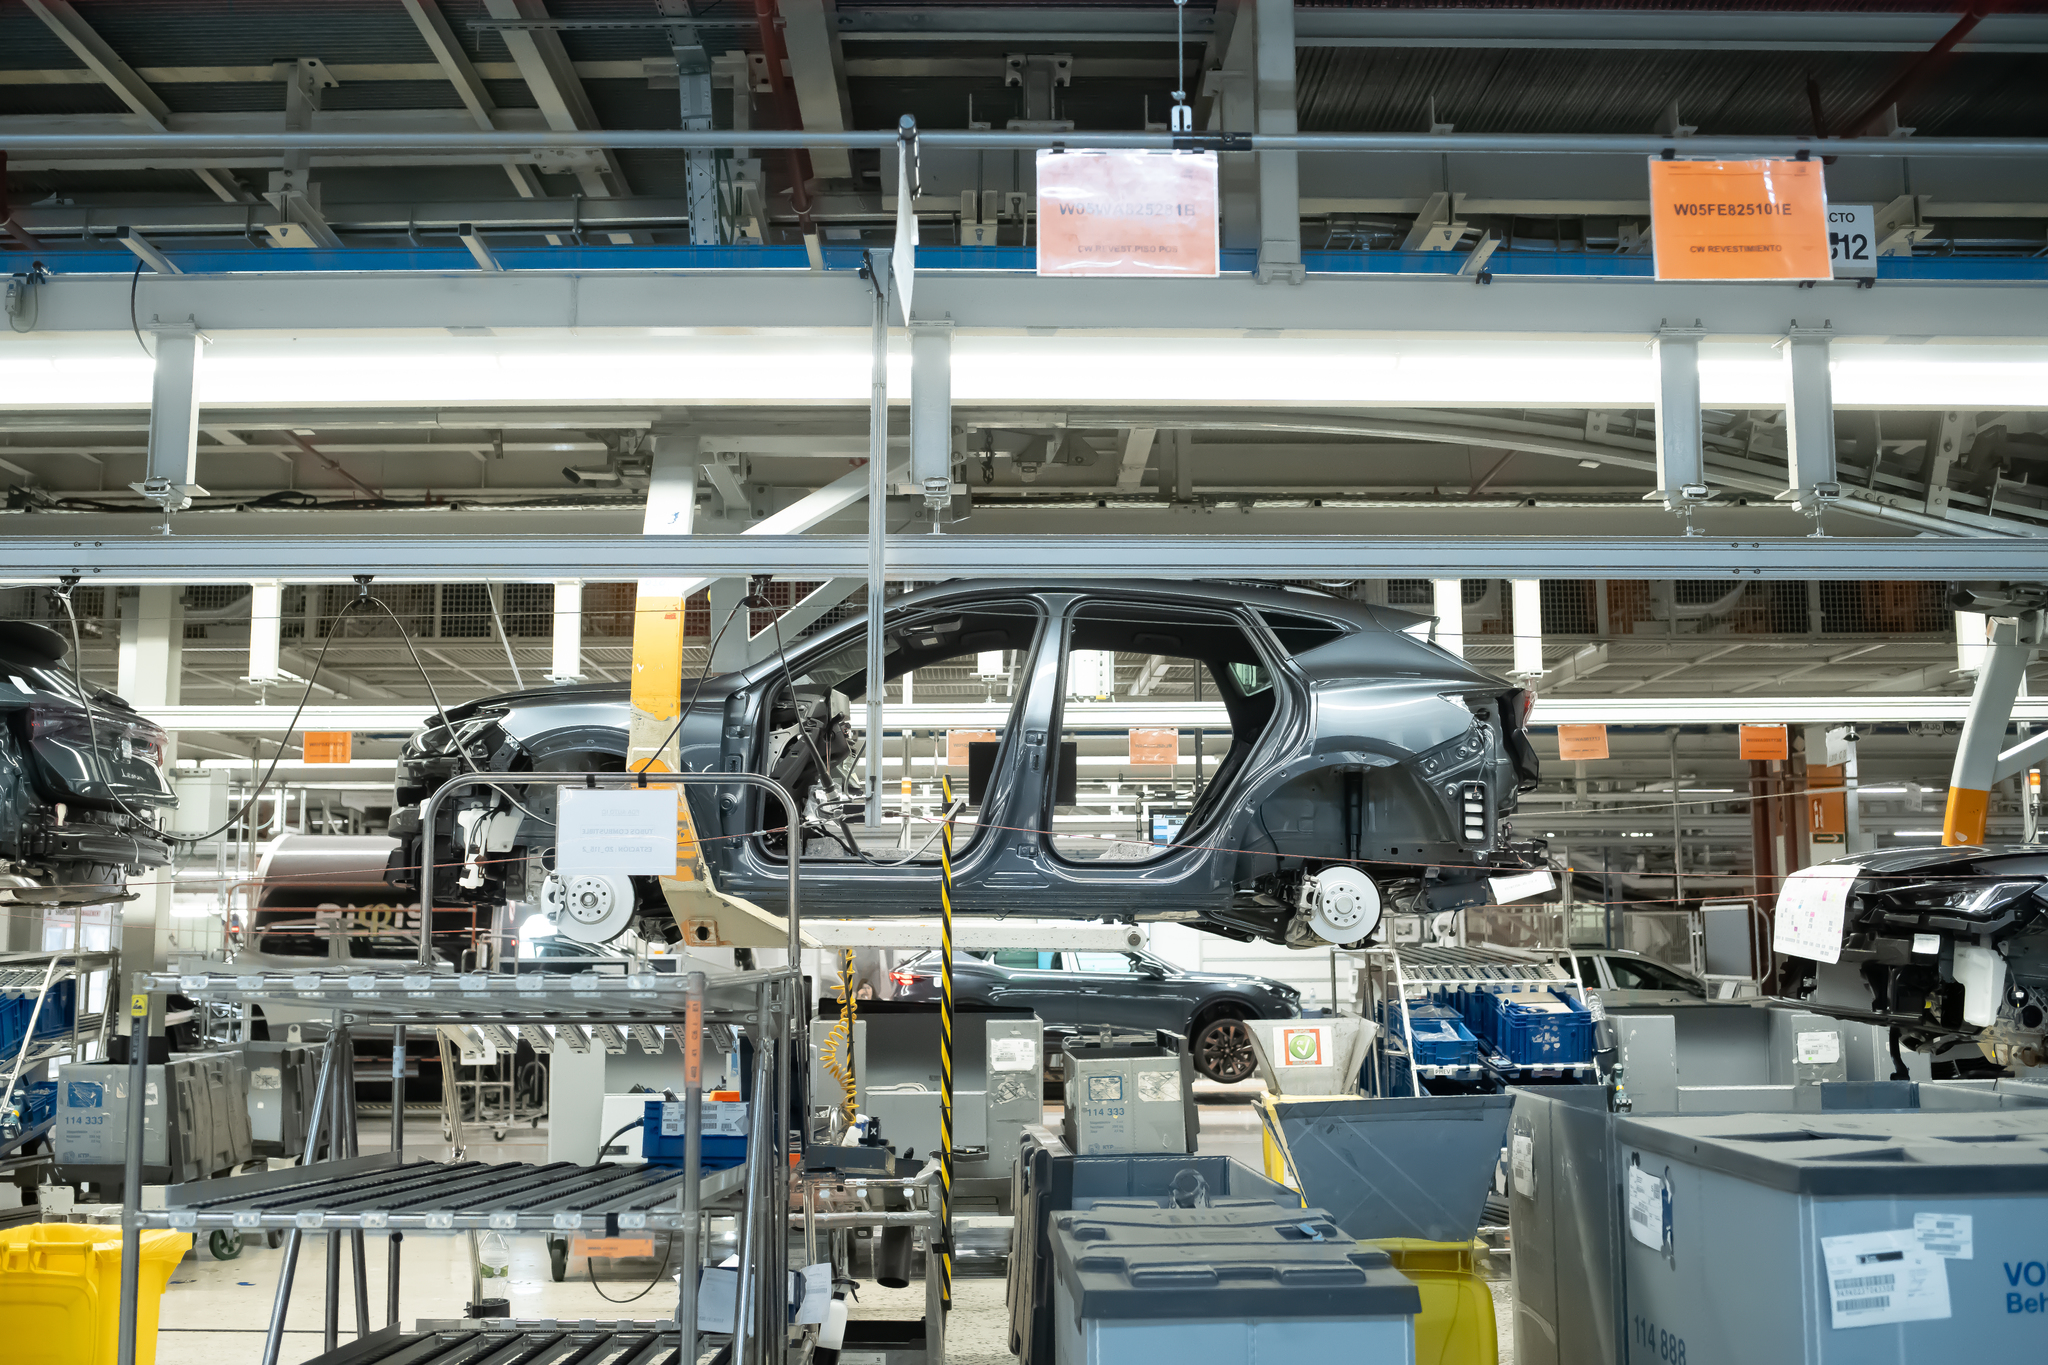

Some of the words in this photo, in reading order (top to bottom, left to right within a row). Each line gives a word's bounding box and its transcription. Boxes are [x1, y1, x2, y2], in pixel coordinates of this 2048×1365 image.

[1674, 203, 1792, 216] W05FE825101E
[1827, 212, 1855, 223] CTO
[1689, 245, 1705, 253] CW
[1707, 244, 1783, 253] REVESTIMIENTO
[1087, 1108, 1104, 1116] 114
[1107, 1107, 1125, 1116] 333
[65, 1116, 82, 1125] 114
[85, 1116, 103, 1125] 333
[2003, 1261, 2048, 1287] VO
[1634, 1314, 1656, 1354] 114
[1660, 1328, 1686, 1365] 888
